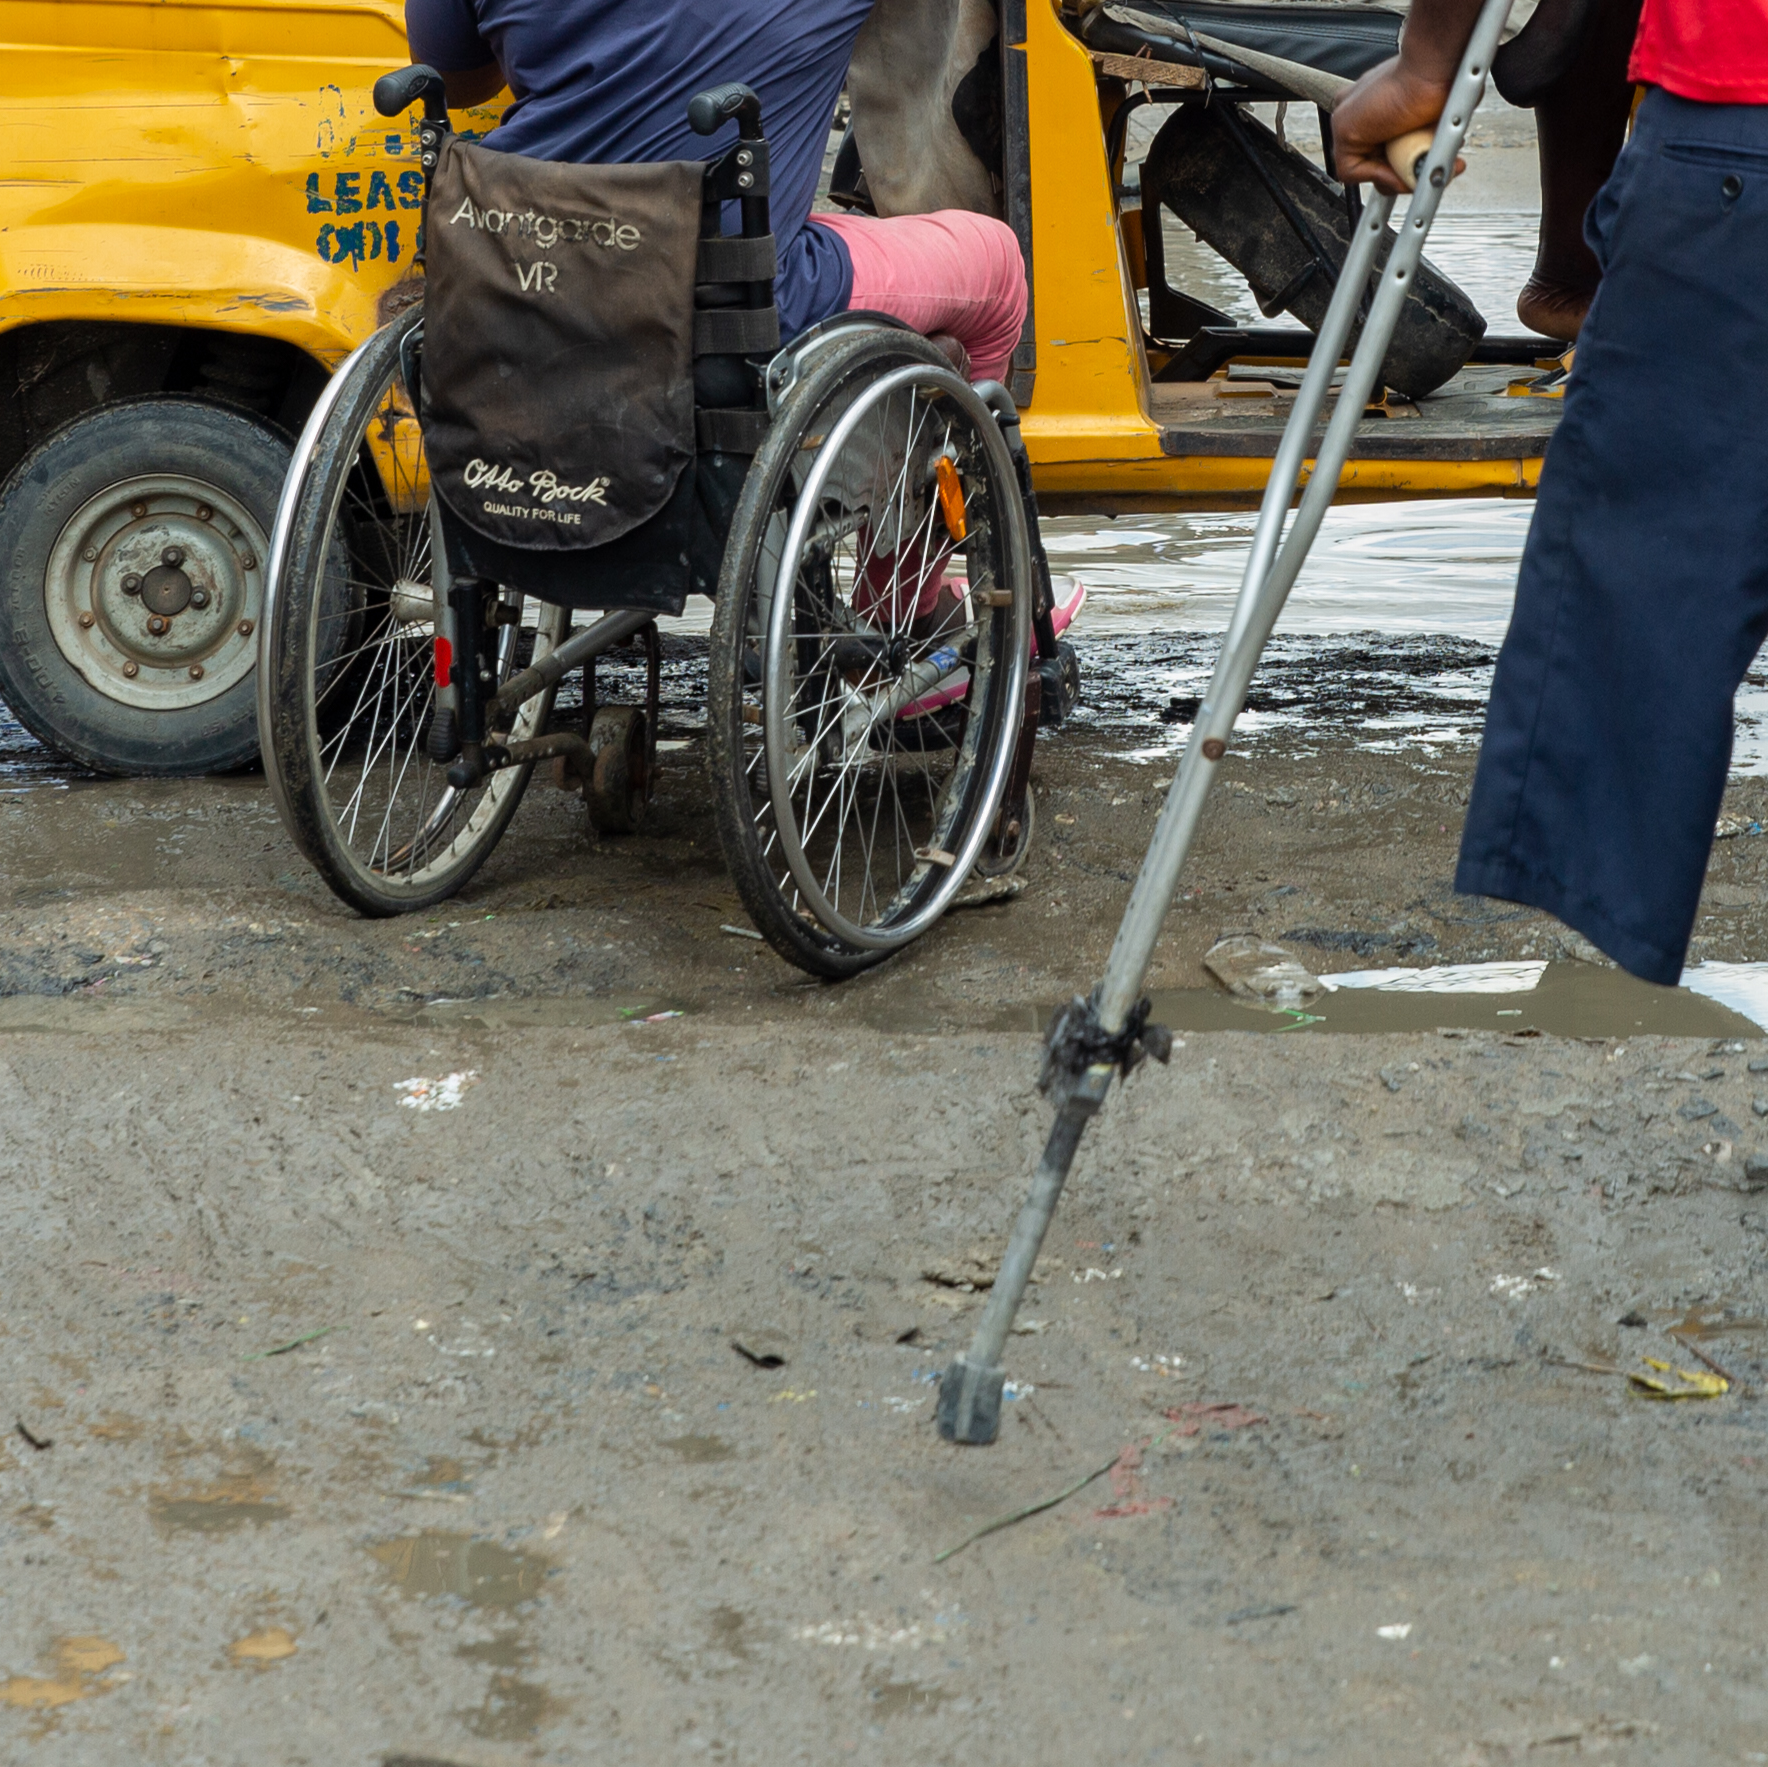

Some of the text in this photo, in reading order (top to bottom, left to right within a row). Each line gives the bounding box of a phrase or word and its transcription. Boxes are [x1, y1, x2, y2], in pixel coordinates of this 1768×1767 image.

[449, 196, 641, 251] Avantgarde
[514, 260, 558, 293] VR
[464, 458, 524, 493] Otto
[483, 501, 582, 525] QUALITY FOR LIFE
